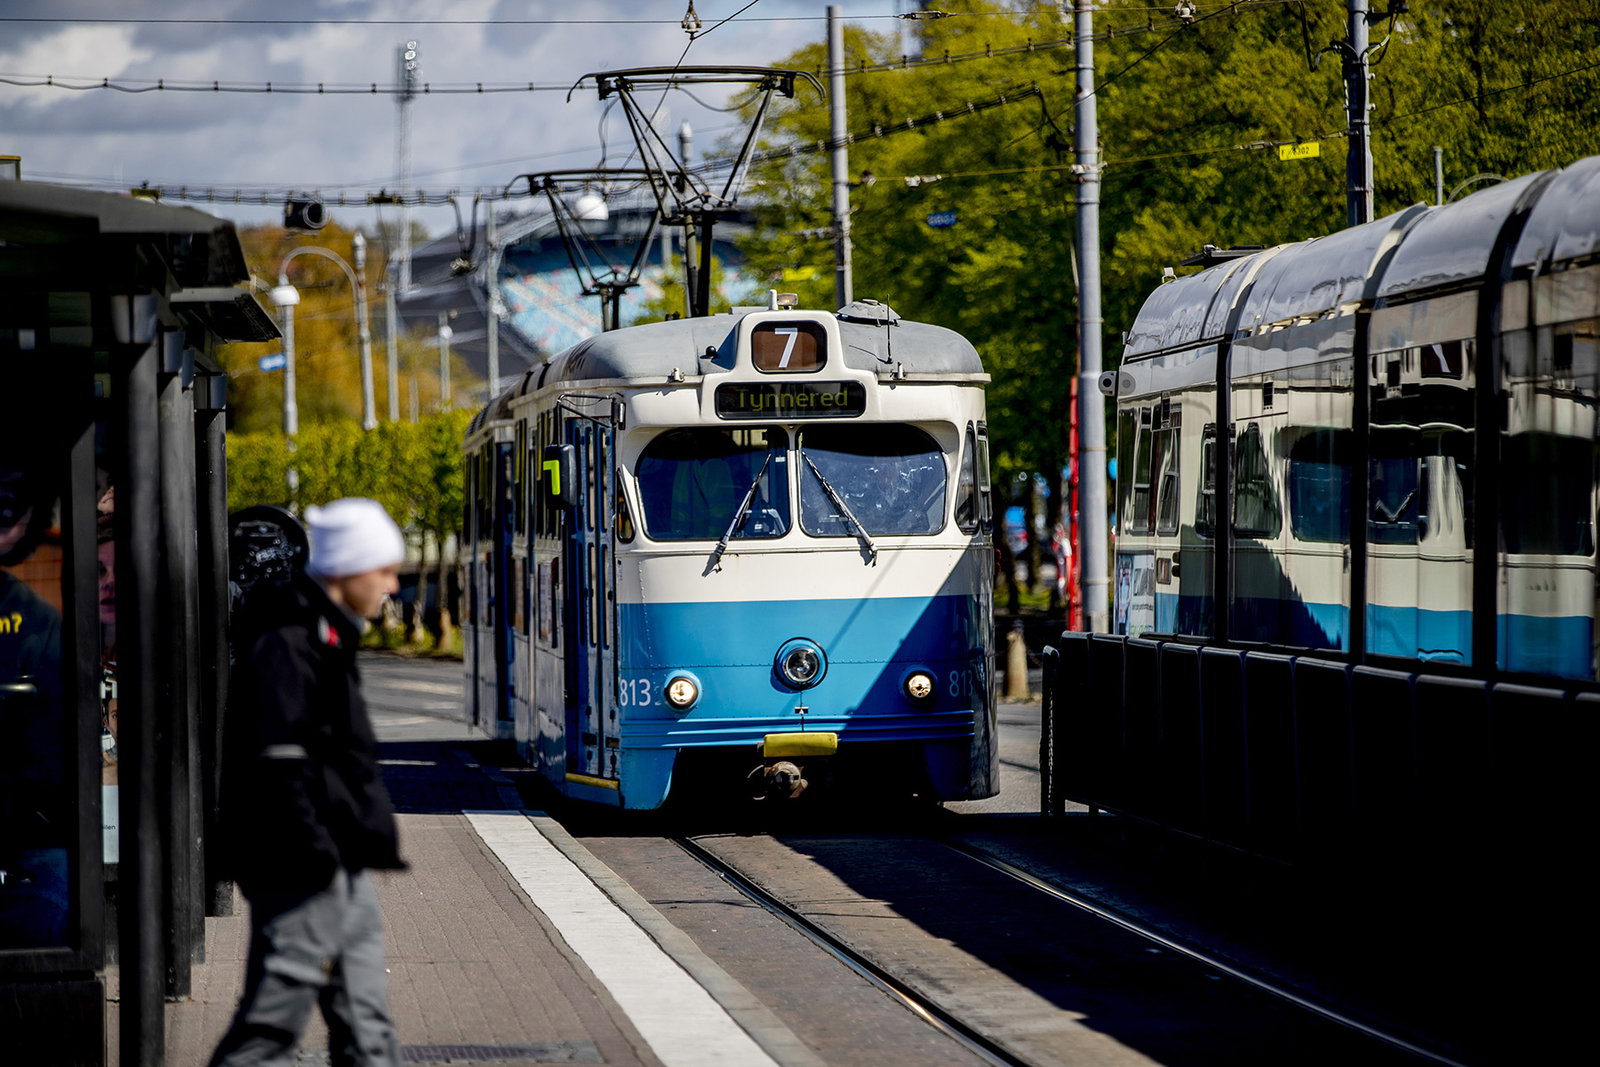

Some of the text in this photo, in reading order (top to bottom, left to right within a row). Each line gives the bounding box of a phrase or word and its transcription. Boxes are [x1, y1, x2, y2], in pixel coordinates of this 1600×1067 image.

[774, 327, 798, 368] 7
[735, 387, 848, 412] Tynnered
[620, 678, 651, 706] 813
[949, 670, 974, 697] 813
